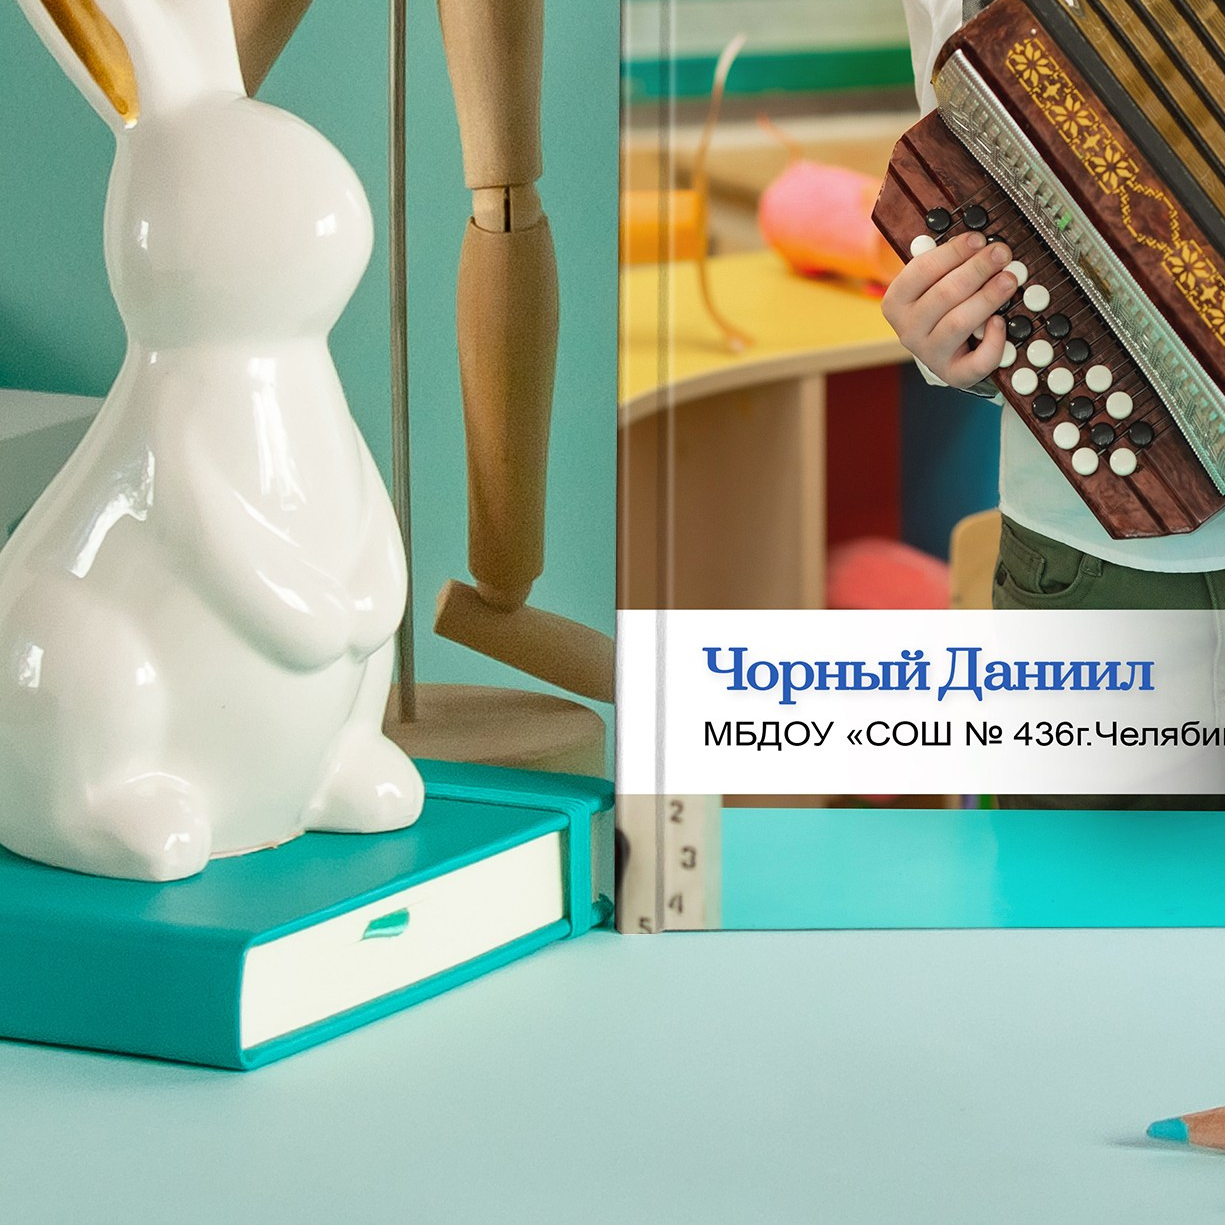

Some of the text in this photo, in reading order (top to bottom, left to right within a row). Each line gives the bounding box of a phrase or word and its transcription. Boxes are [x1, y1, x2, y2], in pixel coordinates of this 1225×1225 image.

[669, 799, 684, 824] 2
[680, 844, 697, 870] 3
[668, 892, 683, 915] 4
